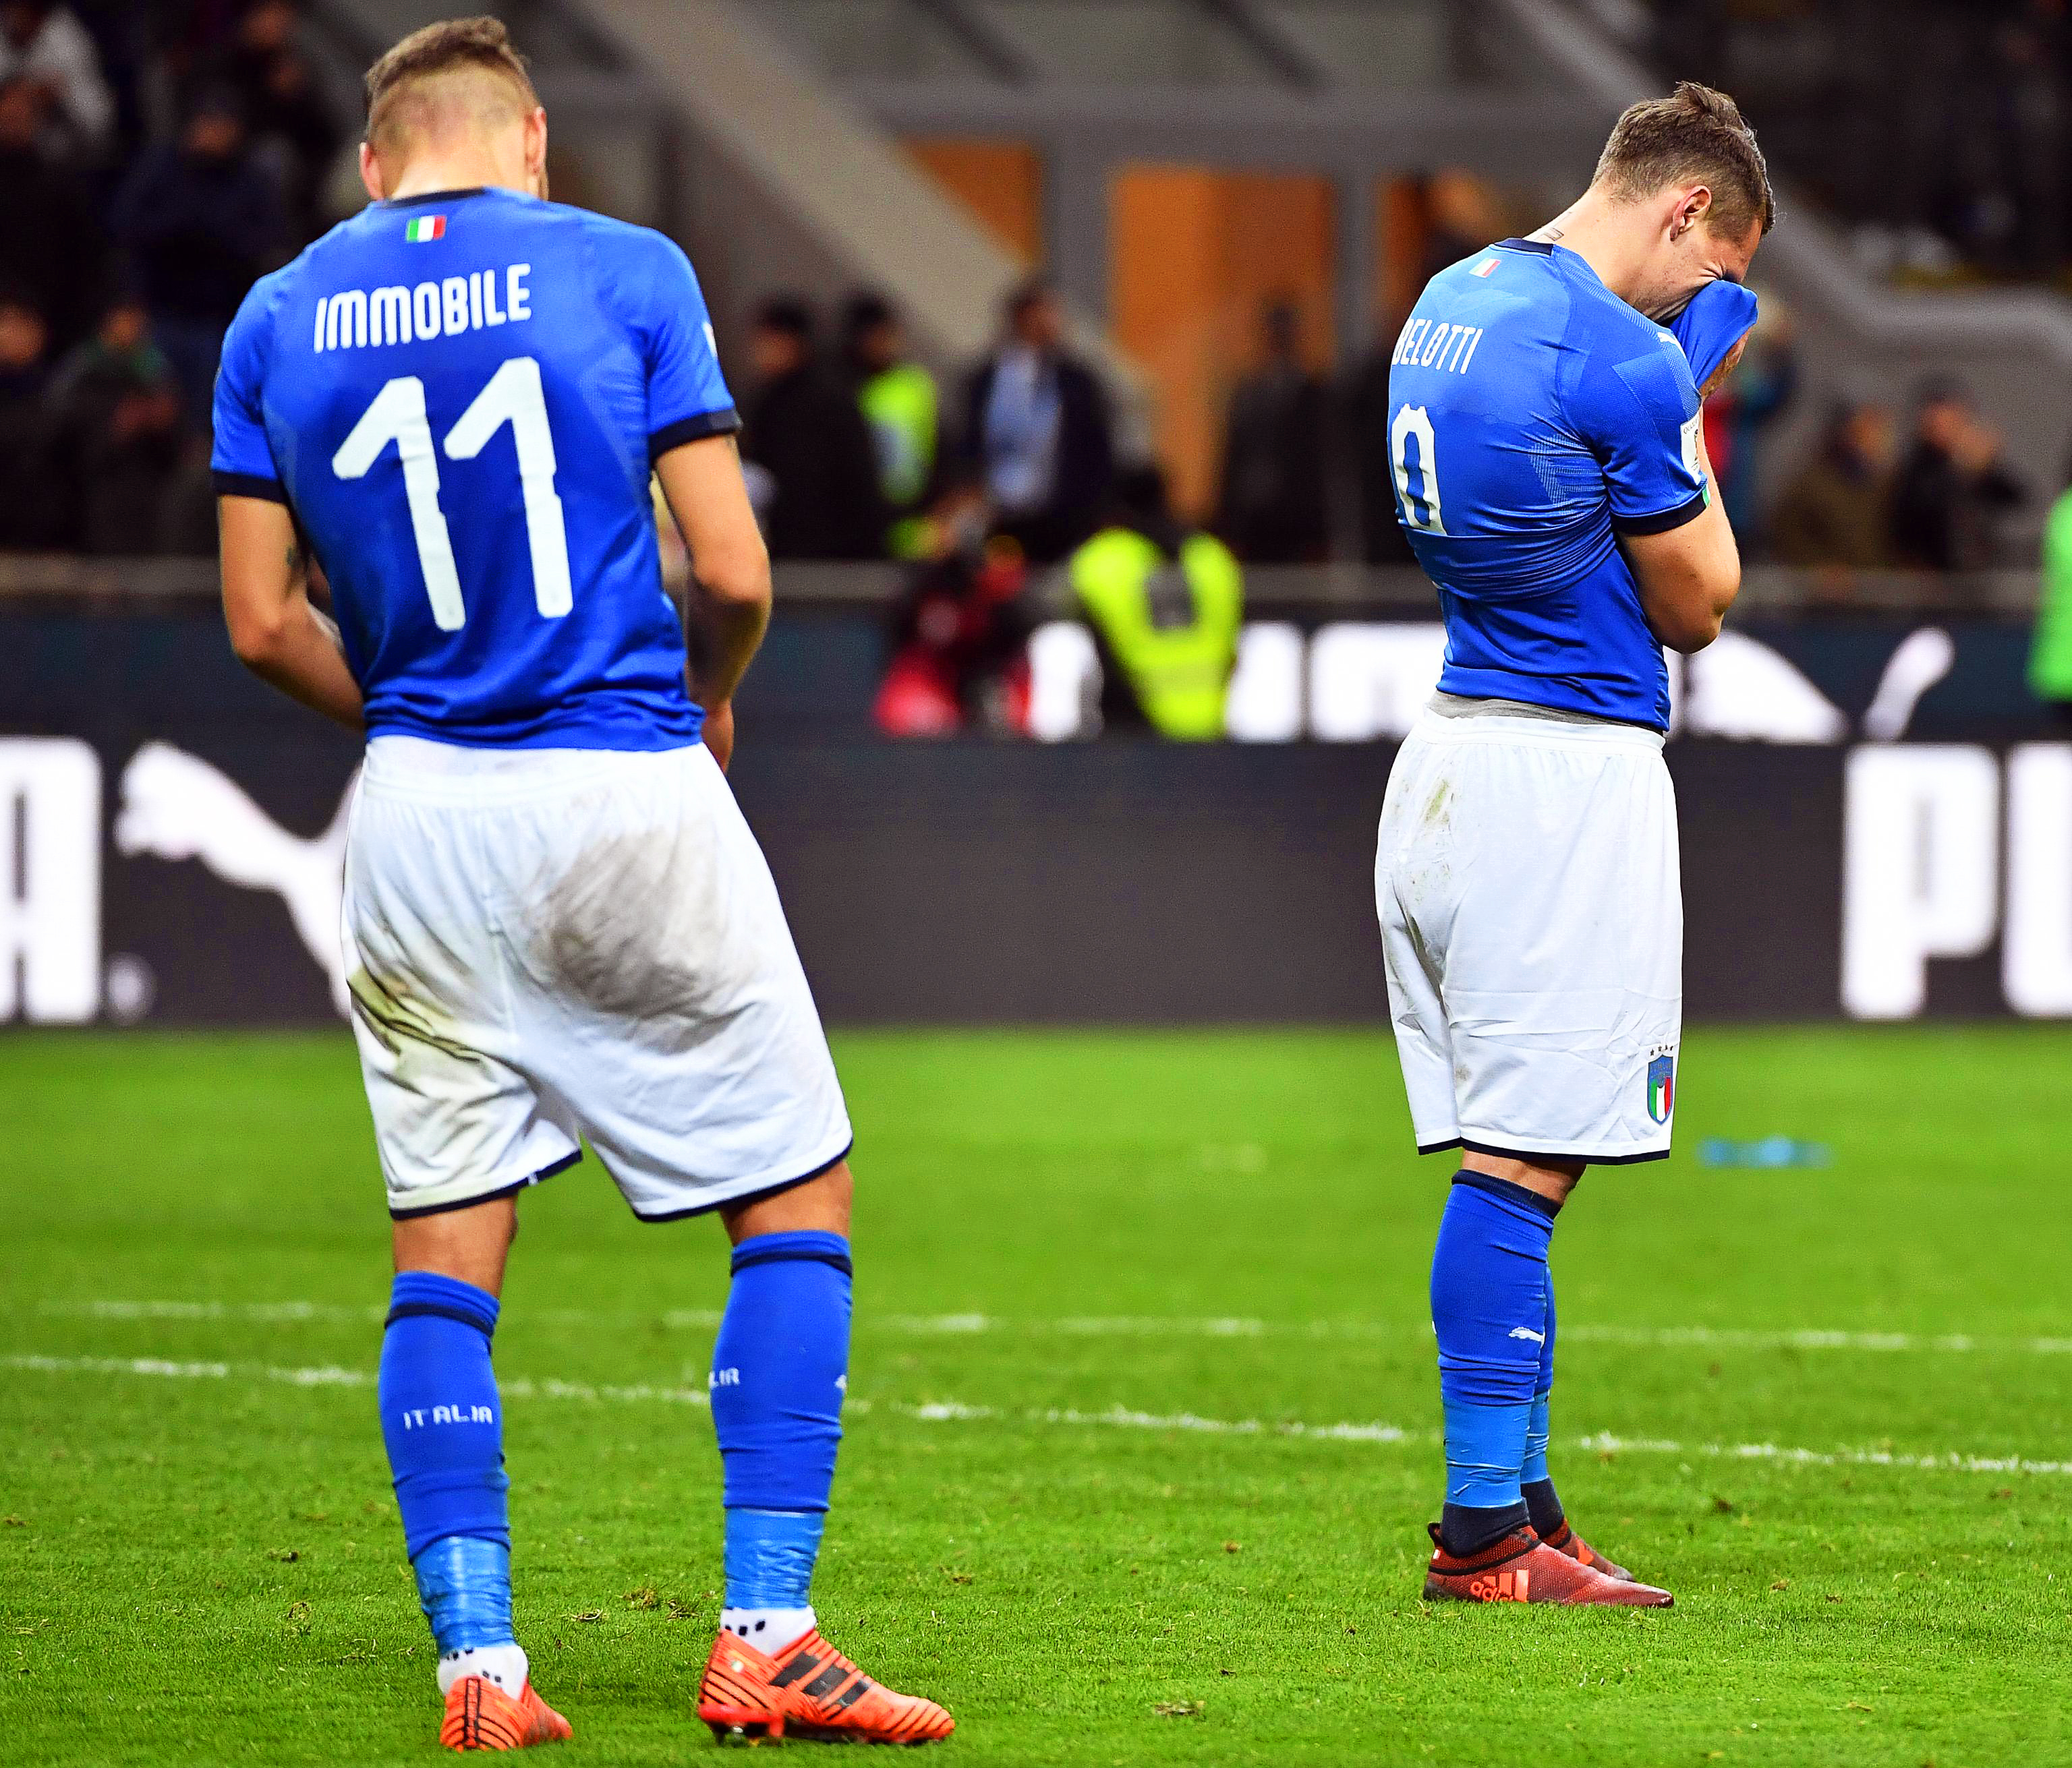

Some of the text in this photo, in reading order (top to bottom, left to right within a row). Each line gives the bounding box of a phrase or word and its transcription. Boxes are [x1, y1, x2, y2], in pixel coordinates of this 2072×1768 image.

[314, 263, 531, 353] IMMOBILE
[332, 355, 573, 632] 11
[403, 1404, 493, 1430] ITALIA
